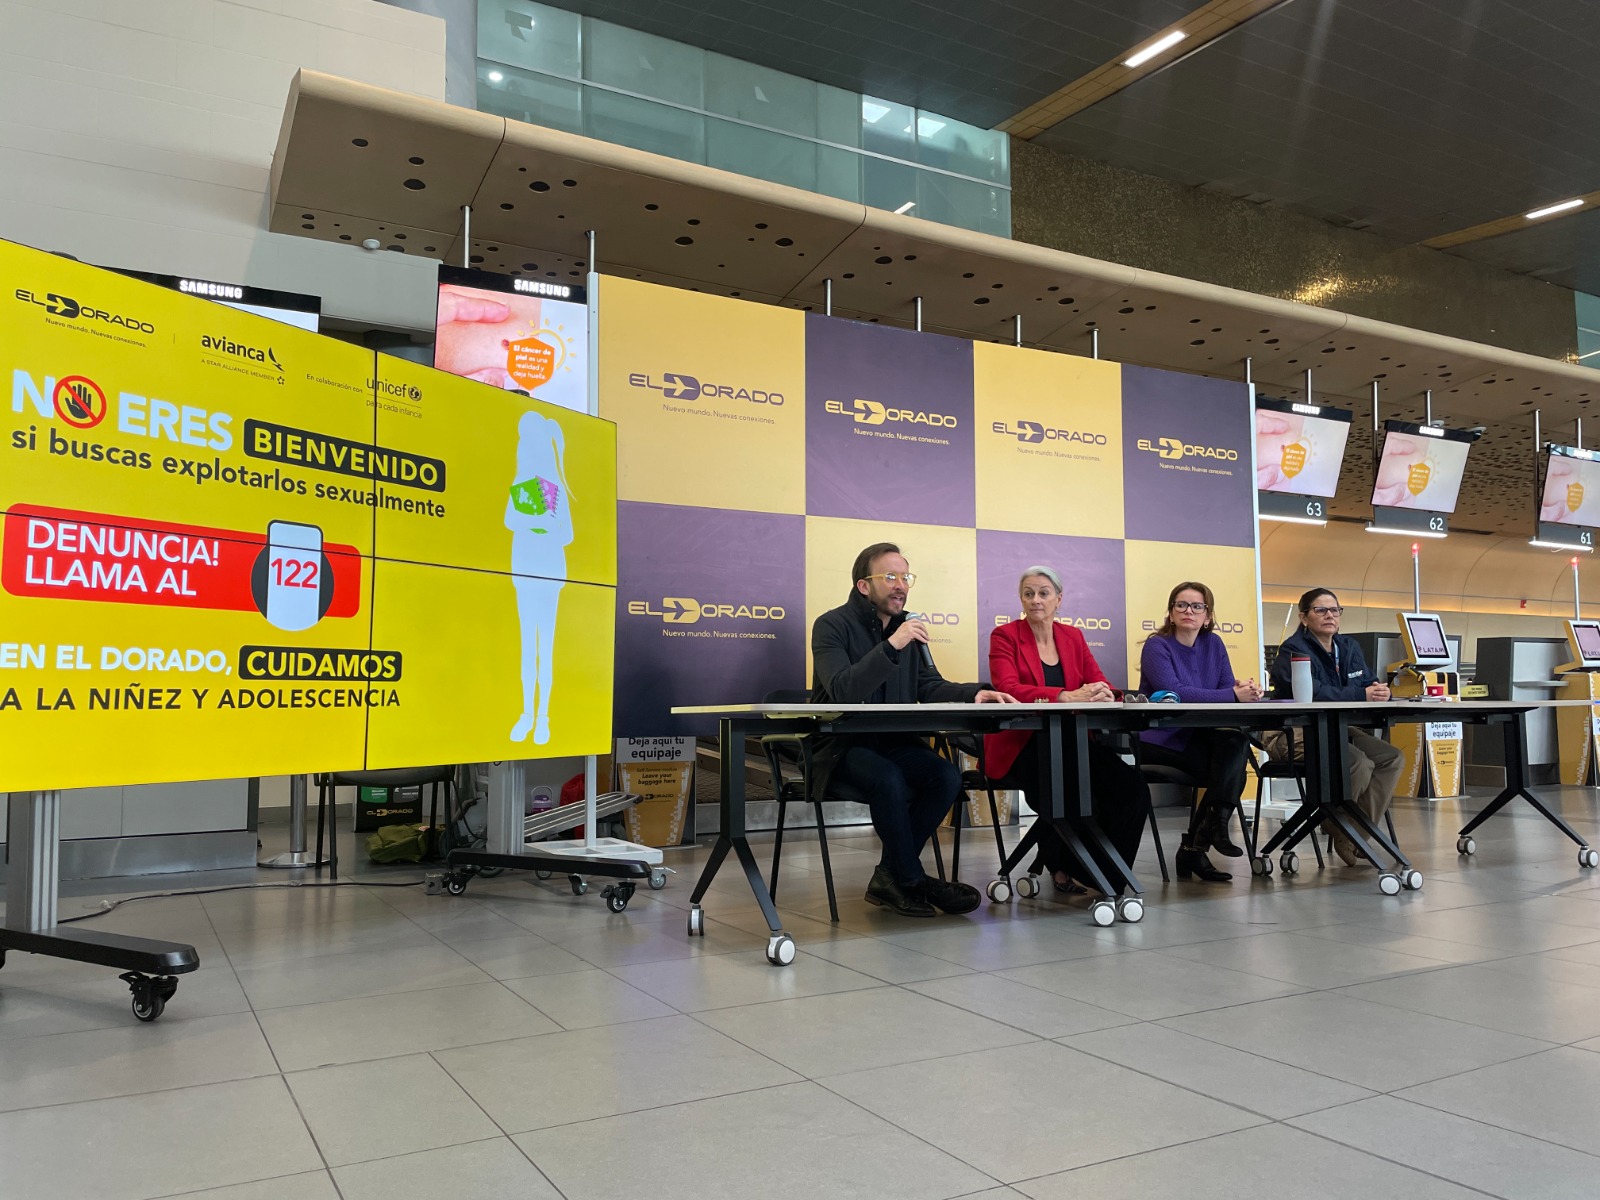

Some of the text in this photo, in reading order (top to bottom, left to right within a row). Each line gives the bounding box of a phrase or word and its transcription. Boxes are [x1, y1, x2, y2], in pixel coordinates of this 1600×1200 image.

[179, 279, 243, 299] SAMSUNG
[514, 279, 570, 298] SAMSUNG
[15, 288, 155, 334] EL DORADO
[45, 317, 147, 348] Nuevo mundo. Nuevas conexiones.
[201, 334, 265, 362] avianca
[521, 346, 541, 354] cáncer
[542, 348, 552, 356] de
[222, 363, 249, 375] ALLIANCE
[513, 371, 527, 379] deja
[516, 363, 540, 371] realidad
[306, 373, 363, 394] En colaboración con
[366, 377, 407, 398] unicef
[629, 372, 785, 406] EL DORADO
[366, 399, 423, 419] para cada infancia
[662, 404, 776, 425] Nuevo mundo. Nuevas conexiones.
[825, 398, 958, 429] EL DORADO
[118, 391, 233, 451] ERES
[254, 426, 439, 487] BIENVENIDO
[853, 427, 951, 446] Nuevo mundo. Nuevas conexiones.
[992, 420, 1107, 446] EL DORADO
[1016, 446, 1034, 455] Nuevo
[1054, 451, 1073, 459] Nuevas
[1137, 437, 1238, 461] EL DORADO
[12, 425, 446, 518] si buscas explotarlos sexualmente
[1159, 462, 1175, 470] Nuevo
[1306, 502, 1322, 517] 63
[1429, 517, 1444, 531] 62
[27, 519, 220, 566] DENUNCIA!
[1580, 532, 1592, 545] 61
[25, 555, 197, 597] LLAMA AL
[270, 557, 319, 589] 122
[627, 597, 786, 624] EL DORADO
[919, 612, 960, 626] ADO
[662, 629, 777, 640] Nuevo mundo. Nuevas conexiones.
[0, 643, 396, 679] EN EL DORADO, CUIDAMOS
[0, 682, 401, 711] A LA NIÑEZ Y ADOLESCENCIA
[629, 737, 649, 747] Deja
[675, 736, 684, 744] tu
[1432, 729, 1455, 738] equipaje
[631, 746, 681, 760] equipaje
